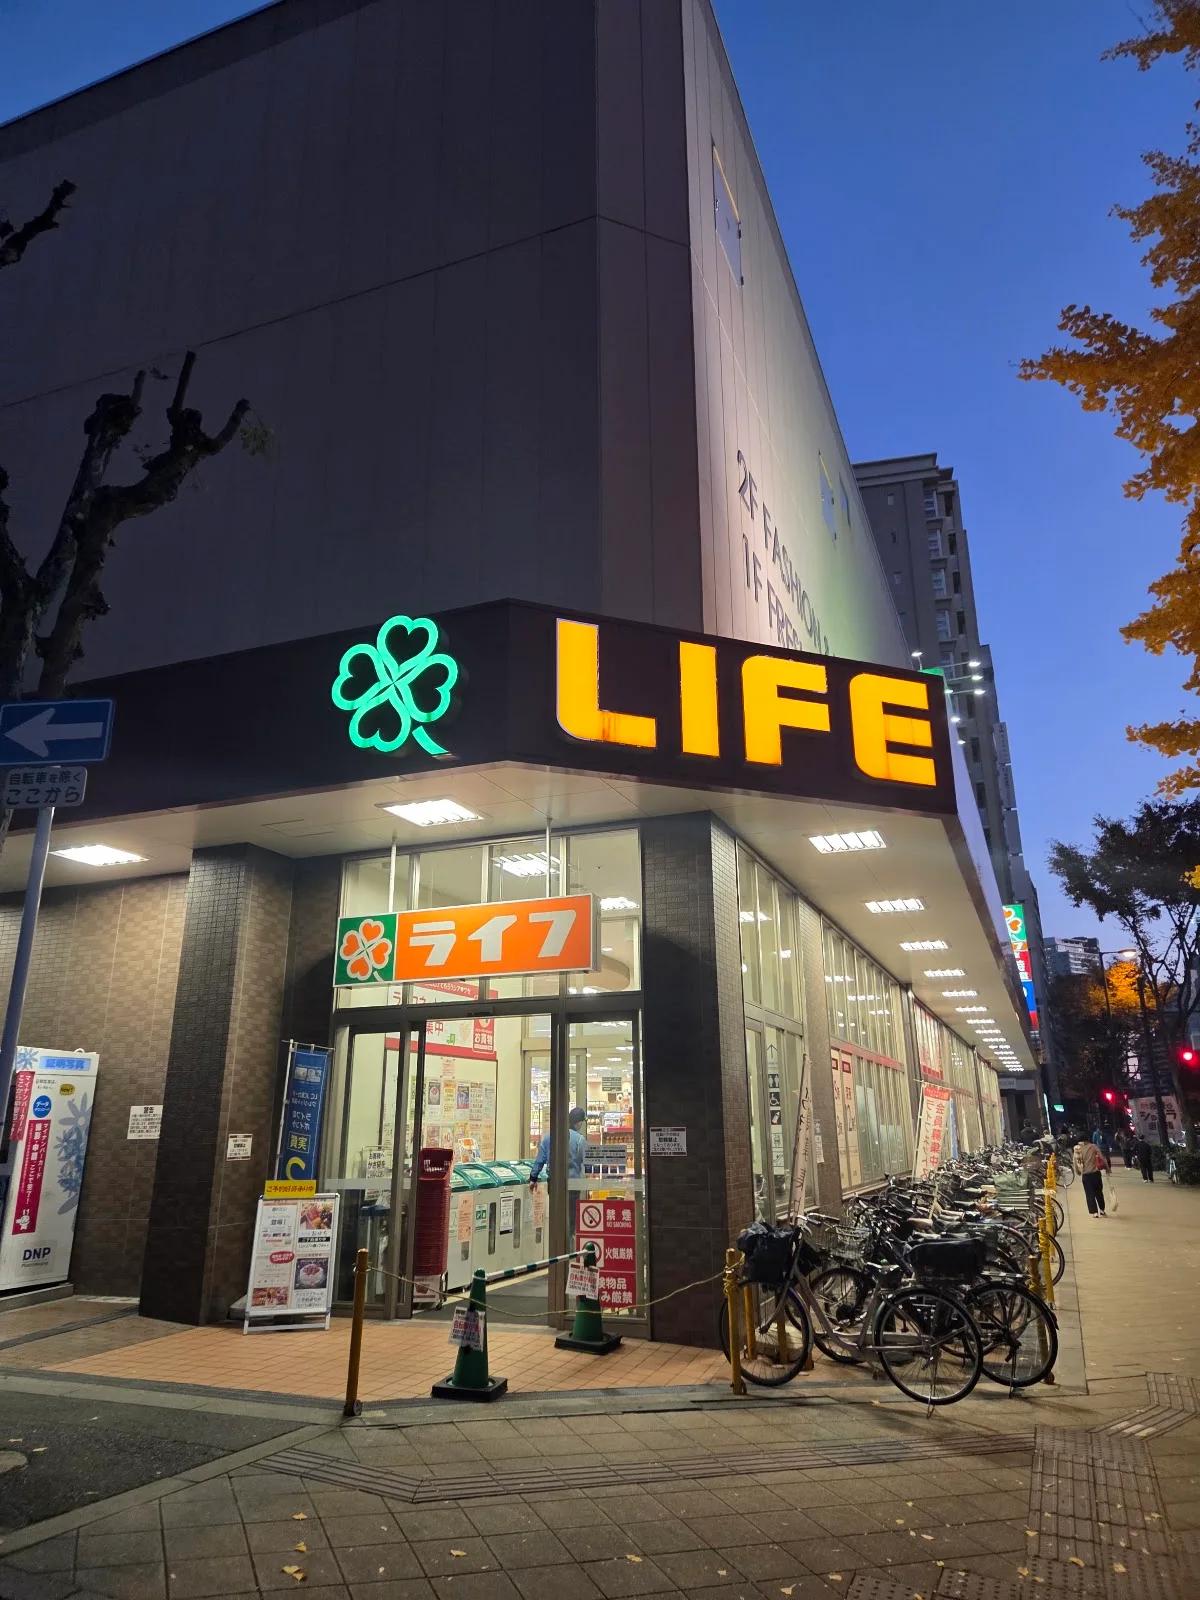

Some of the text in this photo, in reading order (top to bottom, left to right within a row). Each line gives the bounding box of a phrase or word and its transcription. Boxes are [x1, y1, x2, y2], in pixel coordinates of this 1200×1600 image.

[737, 449, 758, 521] 2F
[762, 502, 821, 653] FASHION
[742, 533, 763, 603] 1F
[556, 618, 937, 786] LIFE
[6, 786, 80, 805] ここから
[9, 771, 81, 786] 自転車を除く
[409, 909, 576, 967] ライフ
[36, 1122, 49, 1179] マイナンバーカード
[22, 1247, 51, 1261] DNP
[605, 1247, 633, 1260] 火気厳禁
[598, 1276, 627, 1290] 険物品
